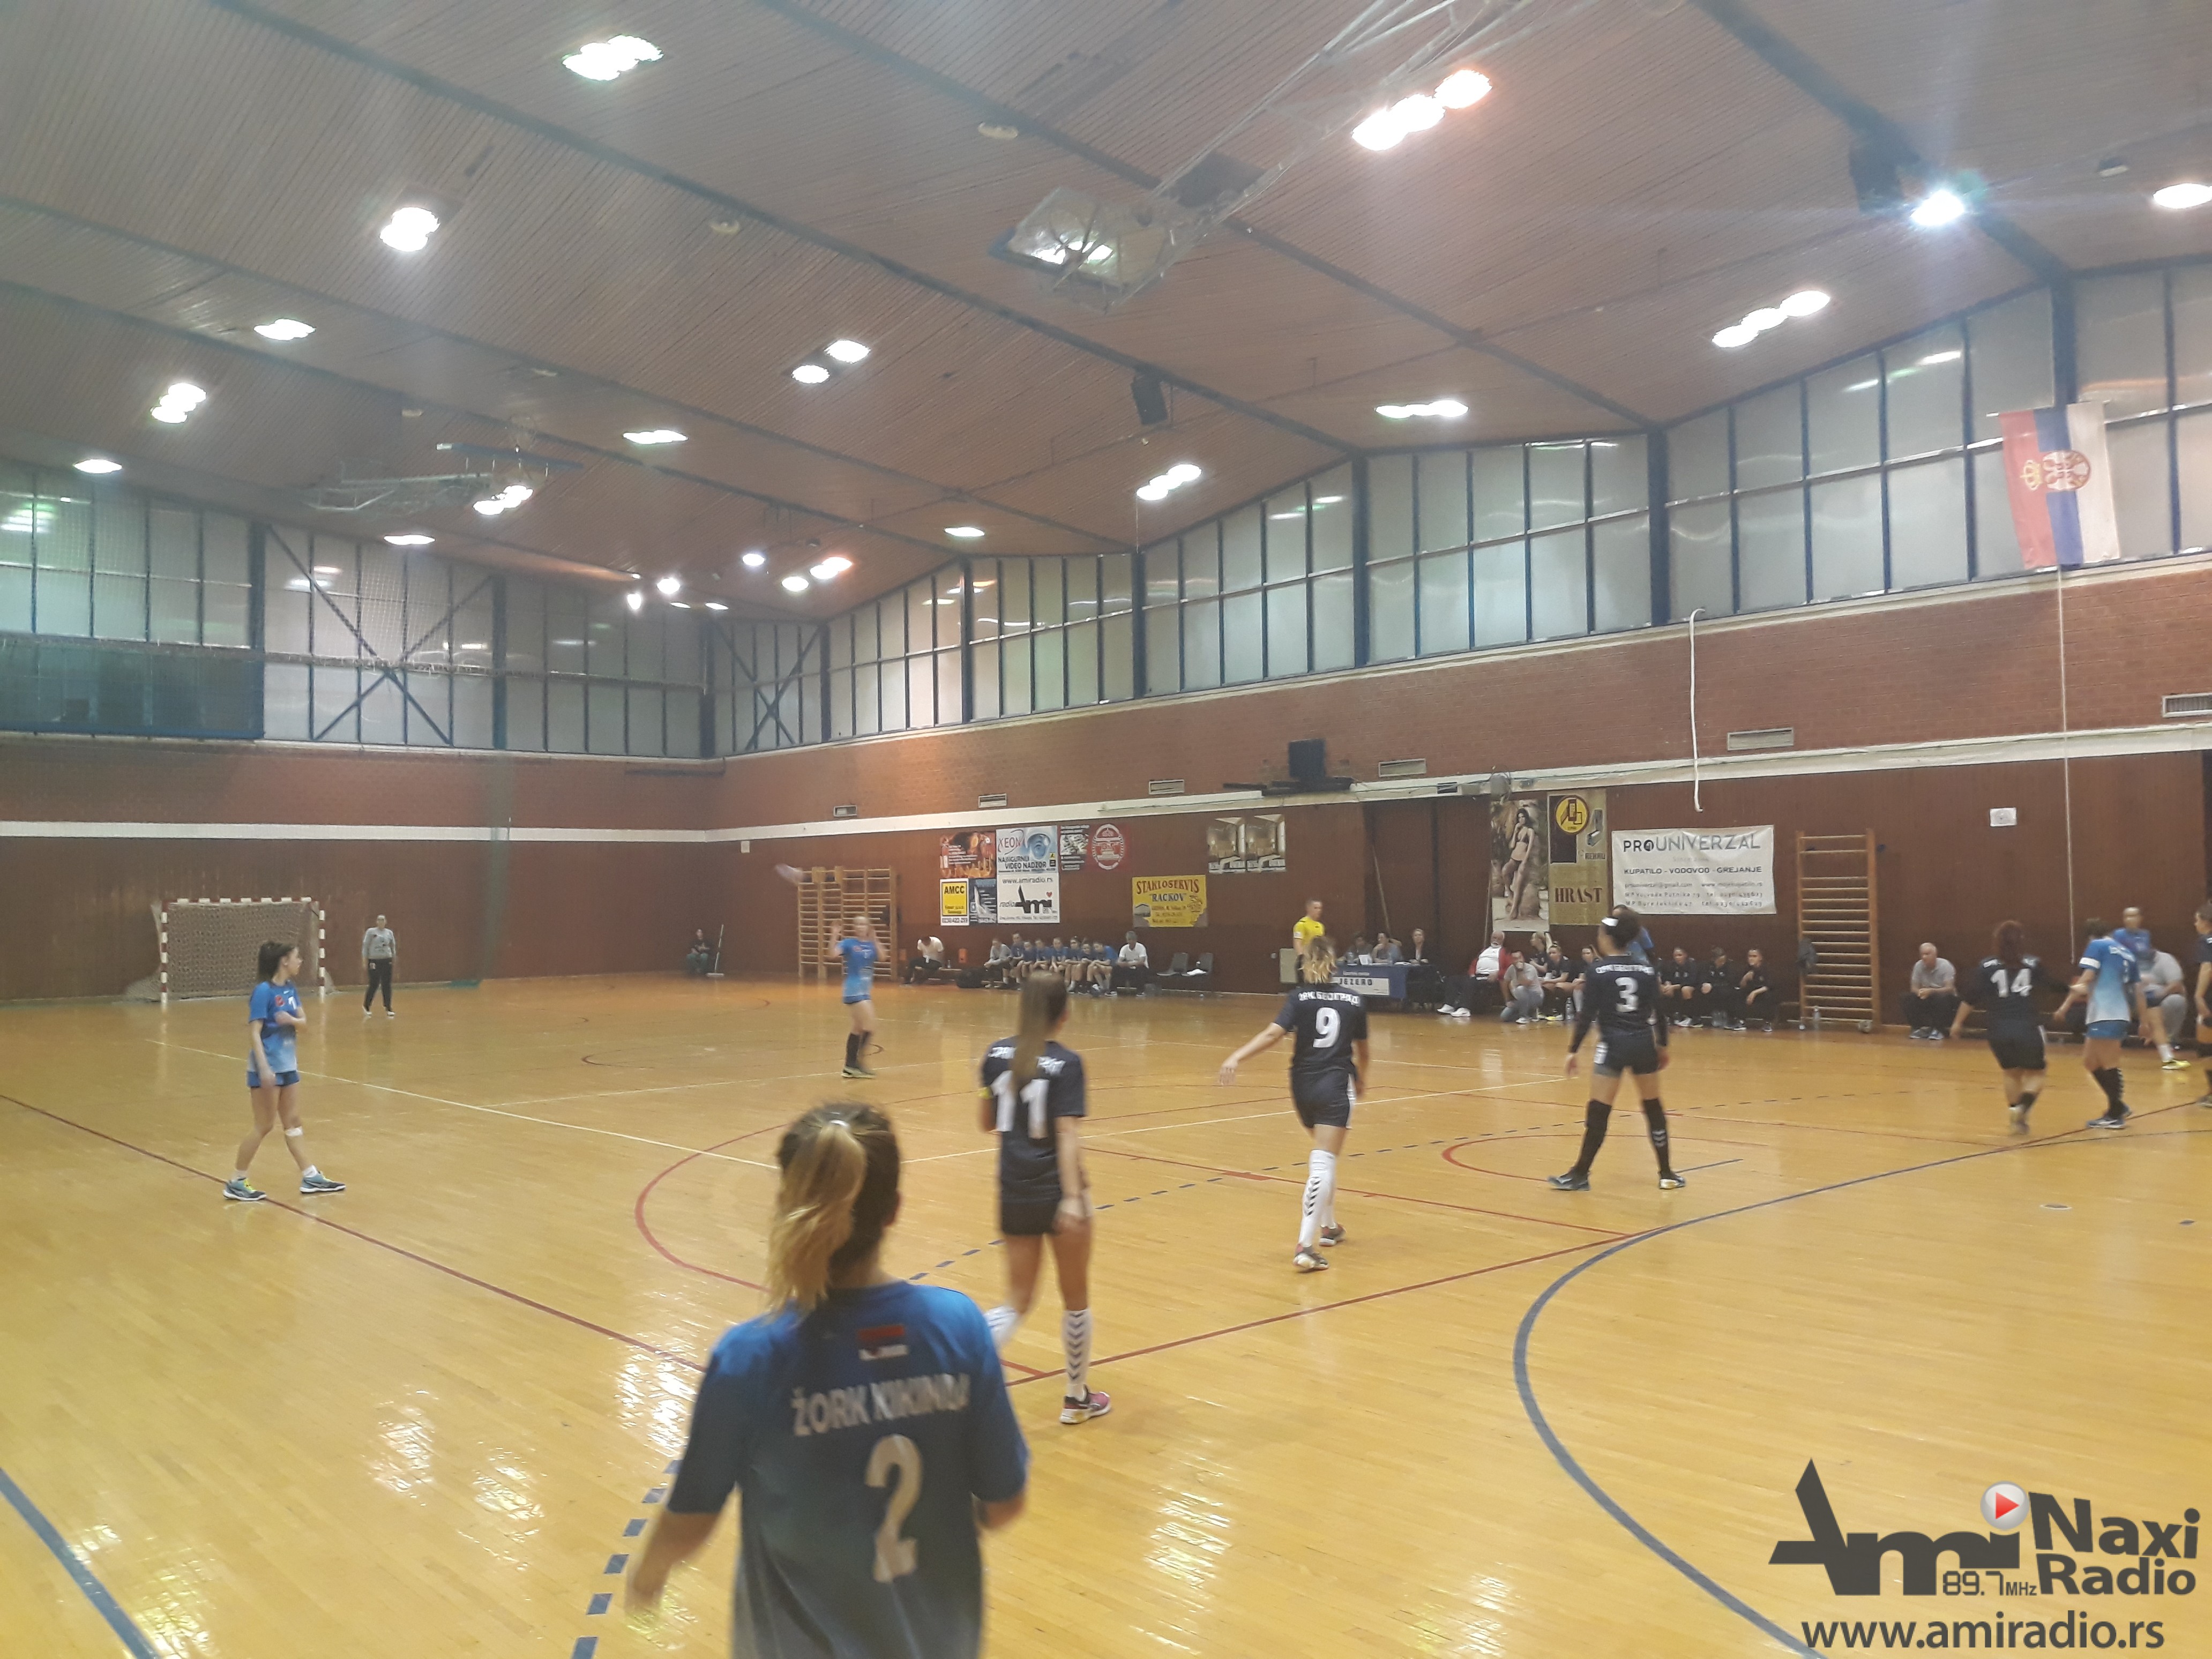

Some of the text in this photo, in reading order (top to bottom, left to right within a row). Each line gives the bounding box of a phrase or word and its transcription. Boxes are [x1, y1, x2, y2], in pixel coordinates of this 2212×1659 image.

[999, 837, 1022, 848] XEON
[1623, 834, 1761, 852] PROUNIVERZAL
[944, 886, 965, 894] AMCC
[1555, 887, 1603, 903] HRAST
[1615, 977, 1639, 1012] 3
[1990, 969, 2032, 998] 14
[1313, 1007, 1340, 1048] 9
[990, 1070, 1050, 1139] 11
[864, 1433, 923, 1584] 2
